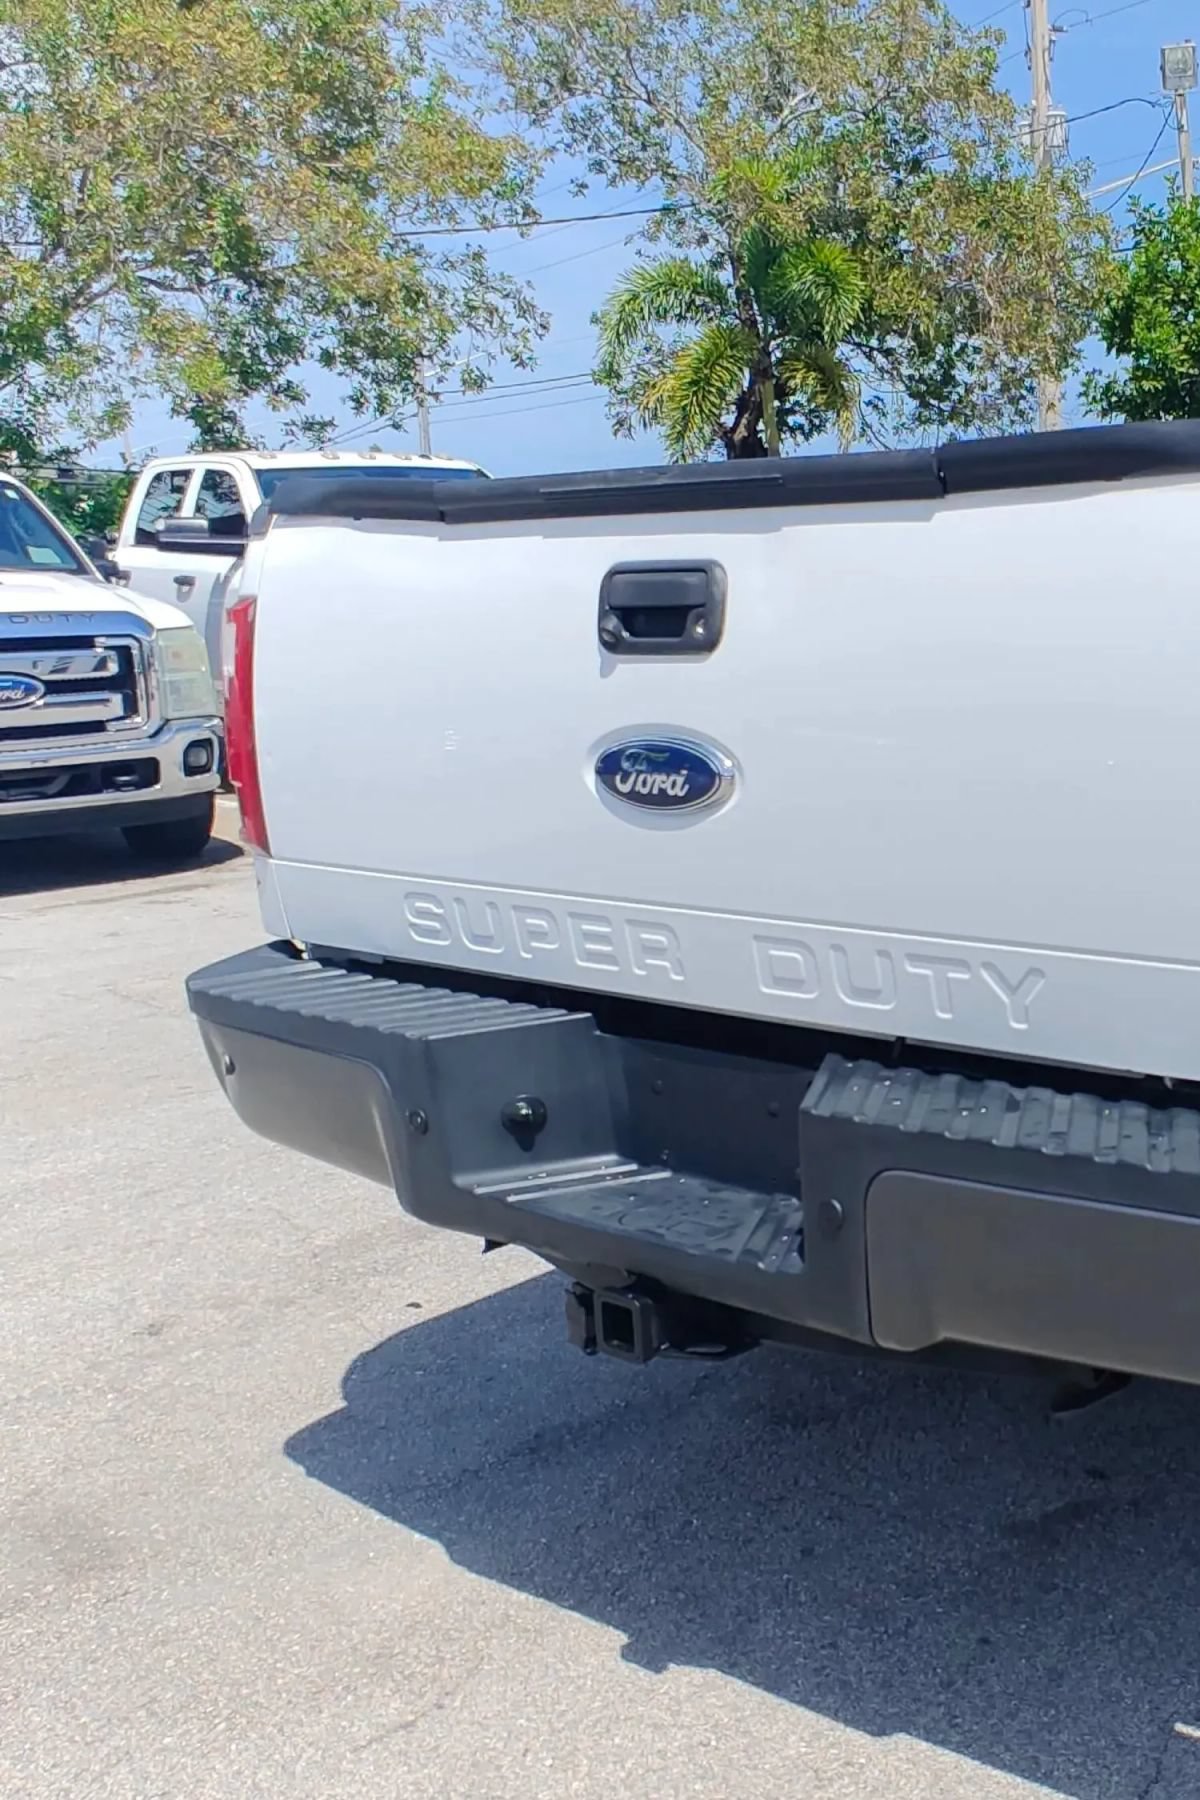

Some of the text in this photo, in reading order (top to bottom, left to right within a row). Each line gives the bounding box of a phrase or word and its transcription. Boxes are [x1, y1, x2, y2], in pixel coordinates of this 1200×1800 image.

[8, 613, 96, 624] DUTY
[615, 748, 690, 797] Ford
[403, 891, 1046, 1030] SUPER DUTY
